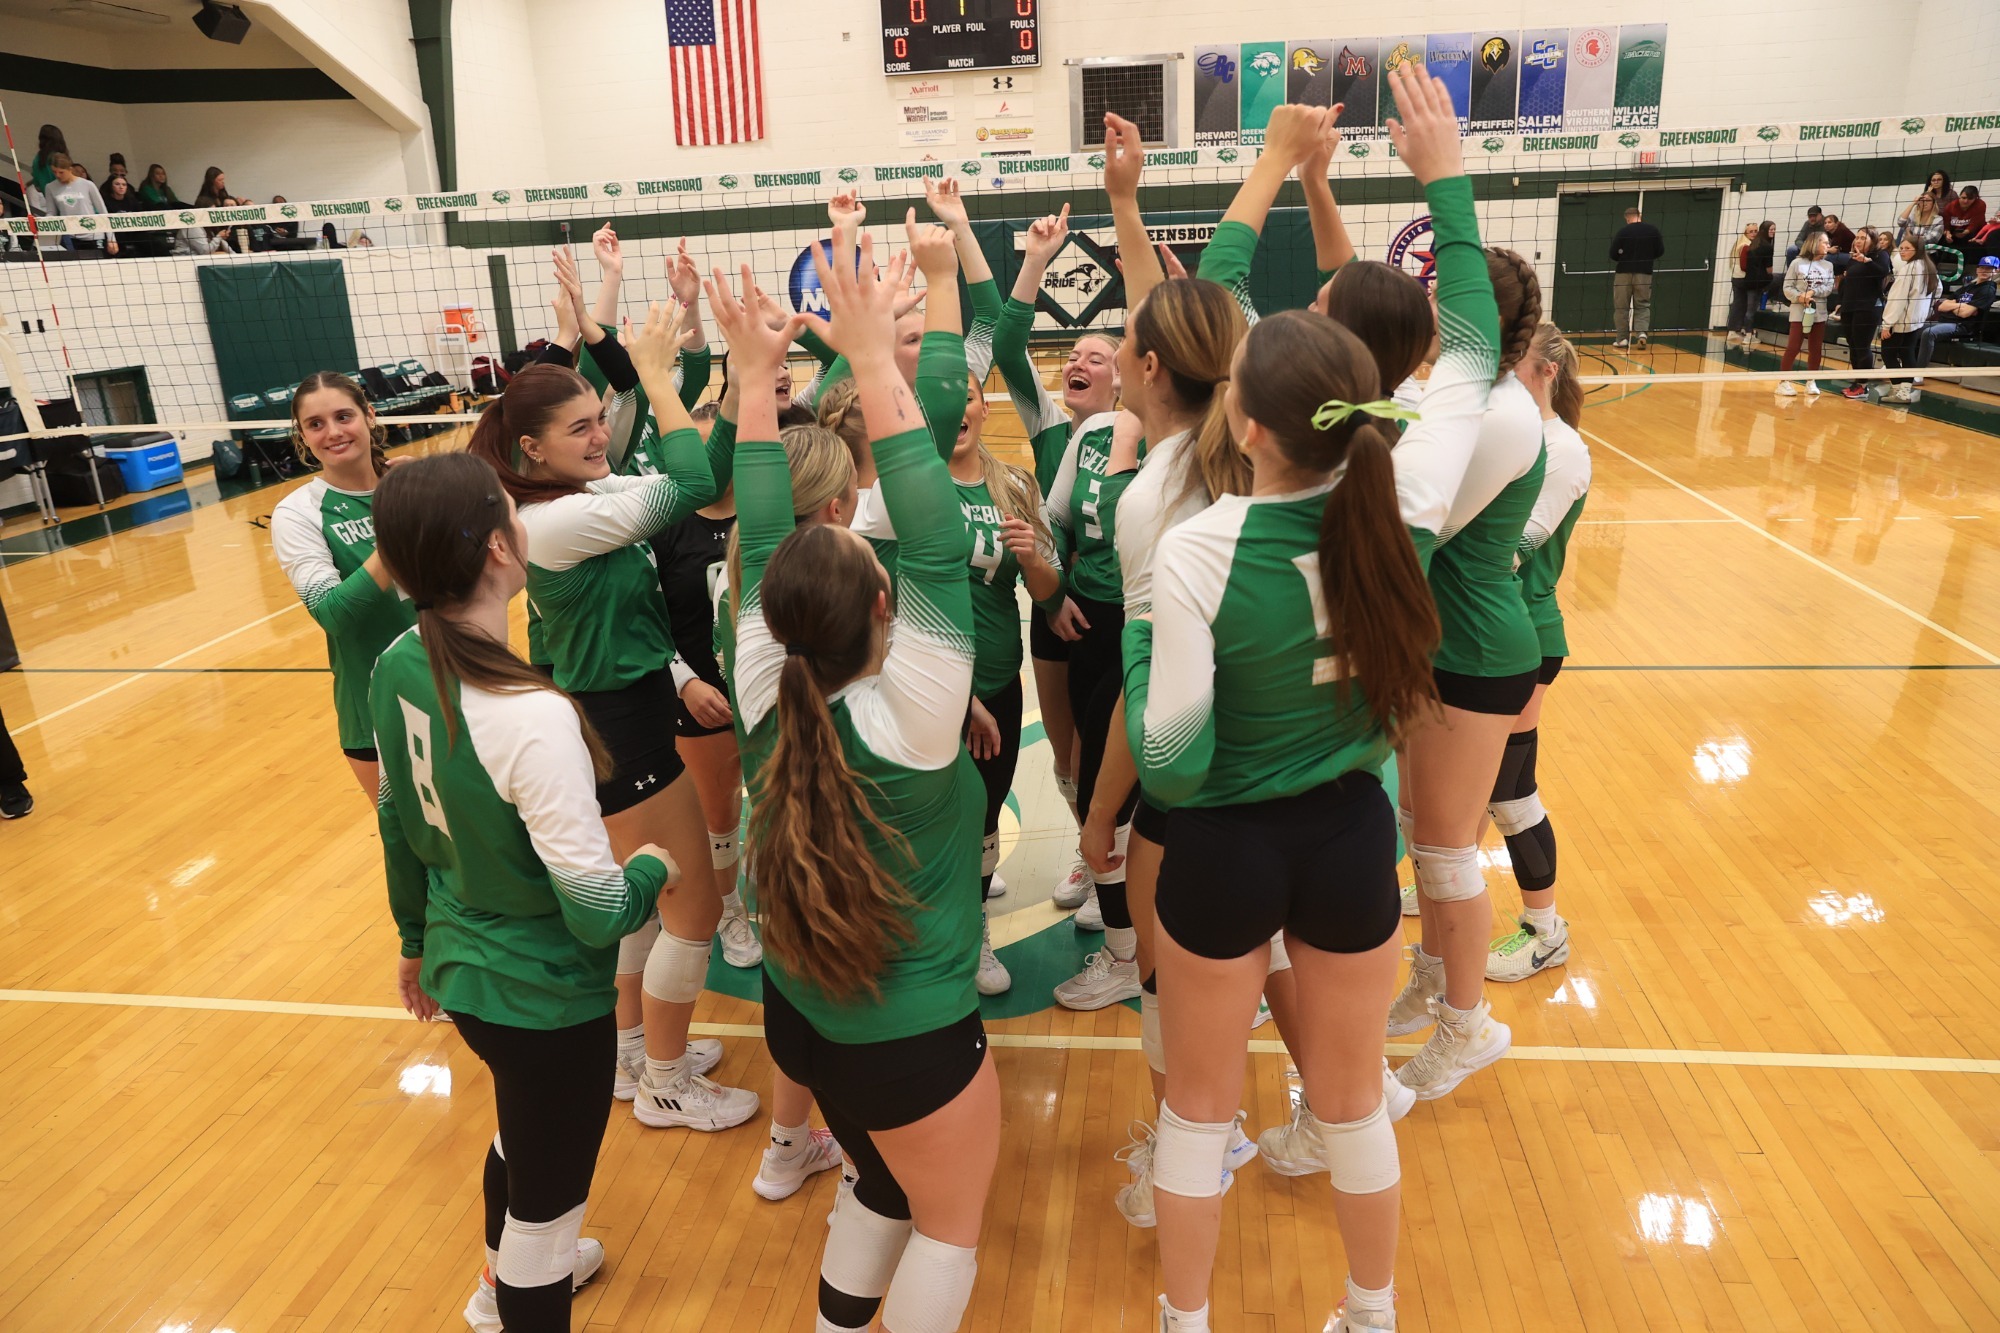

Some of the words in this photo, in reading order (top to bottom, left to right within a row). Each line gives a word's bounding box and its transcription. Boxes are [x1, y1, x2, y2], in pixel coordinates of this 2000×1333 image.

[932, 24, 961, 34] PLAYER
[966, 22, 986, 32] FOUL
[1010, 19, 1035, 29] FOULS
[884, 27, 909, 37] FOULS
[1020, 30, 1032, 50] 0
[894, 38, 907, 58] 0
[948, 58, 974, 68] MATCH
[1011, 54, 1036, 64] SCORE
[886, 62, 911, 72] SCORE
[1566, 108, 1610, 117] SOUTHERN
[1614, 105, 1658, 115] WILLIAM
[1470, 119, 1515, 130] PFEIFFER
[1518, 115, 1562, 128] SALEM
[1566, 116, 1609, 126] VIRGINIA
[1613, 115, 1658, 126] PEACE
[1945, 115, 2000, 133] GREENSB
[1195, 130, 1237, 140] BREVARD
[1517, 127, 1562, 135] COLLEGE
[1659, 128, 1738, 147] GREENSBORO
[1799, 121, 1882, 141] GREENSBORO
[1195, 139, 1238, 148] COLLEGE
[1241, 135, 1265, 145] COLL
[1522, 134, 1599, 152] GREENSBORO
[1143, 150, 1198, 166] EENSBORO
[1640, 152, 1657, 164] EXIT
[874, 164, 943, 181] GREENSBORO
[998, 157, 1070, 175] GREENSBORO
[754, 171, 821, 188] GREENSBORO
[637, 177, 703, 196] GREENSBORO
[524, 185, 588, 203] GREENSBORO
[416, 193, 478, 211] GREENSBORO
[208, 207, 267, 223] GREENSBORO
[311, 201, 371, 217] GREENSBORO
[8, 220, 67, 233] GRESBORO
[109, 214, 166, 230] GREENSBORO
[1146, 227, 1216, 241] EENSBOR
[1046, 271, 1059, 279] THE
[1044, 278, 1076, 289] PRIDE
[397, 694, 453, 842] 8
